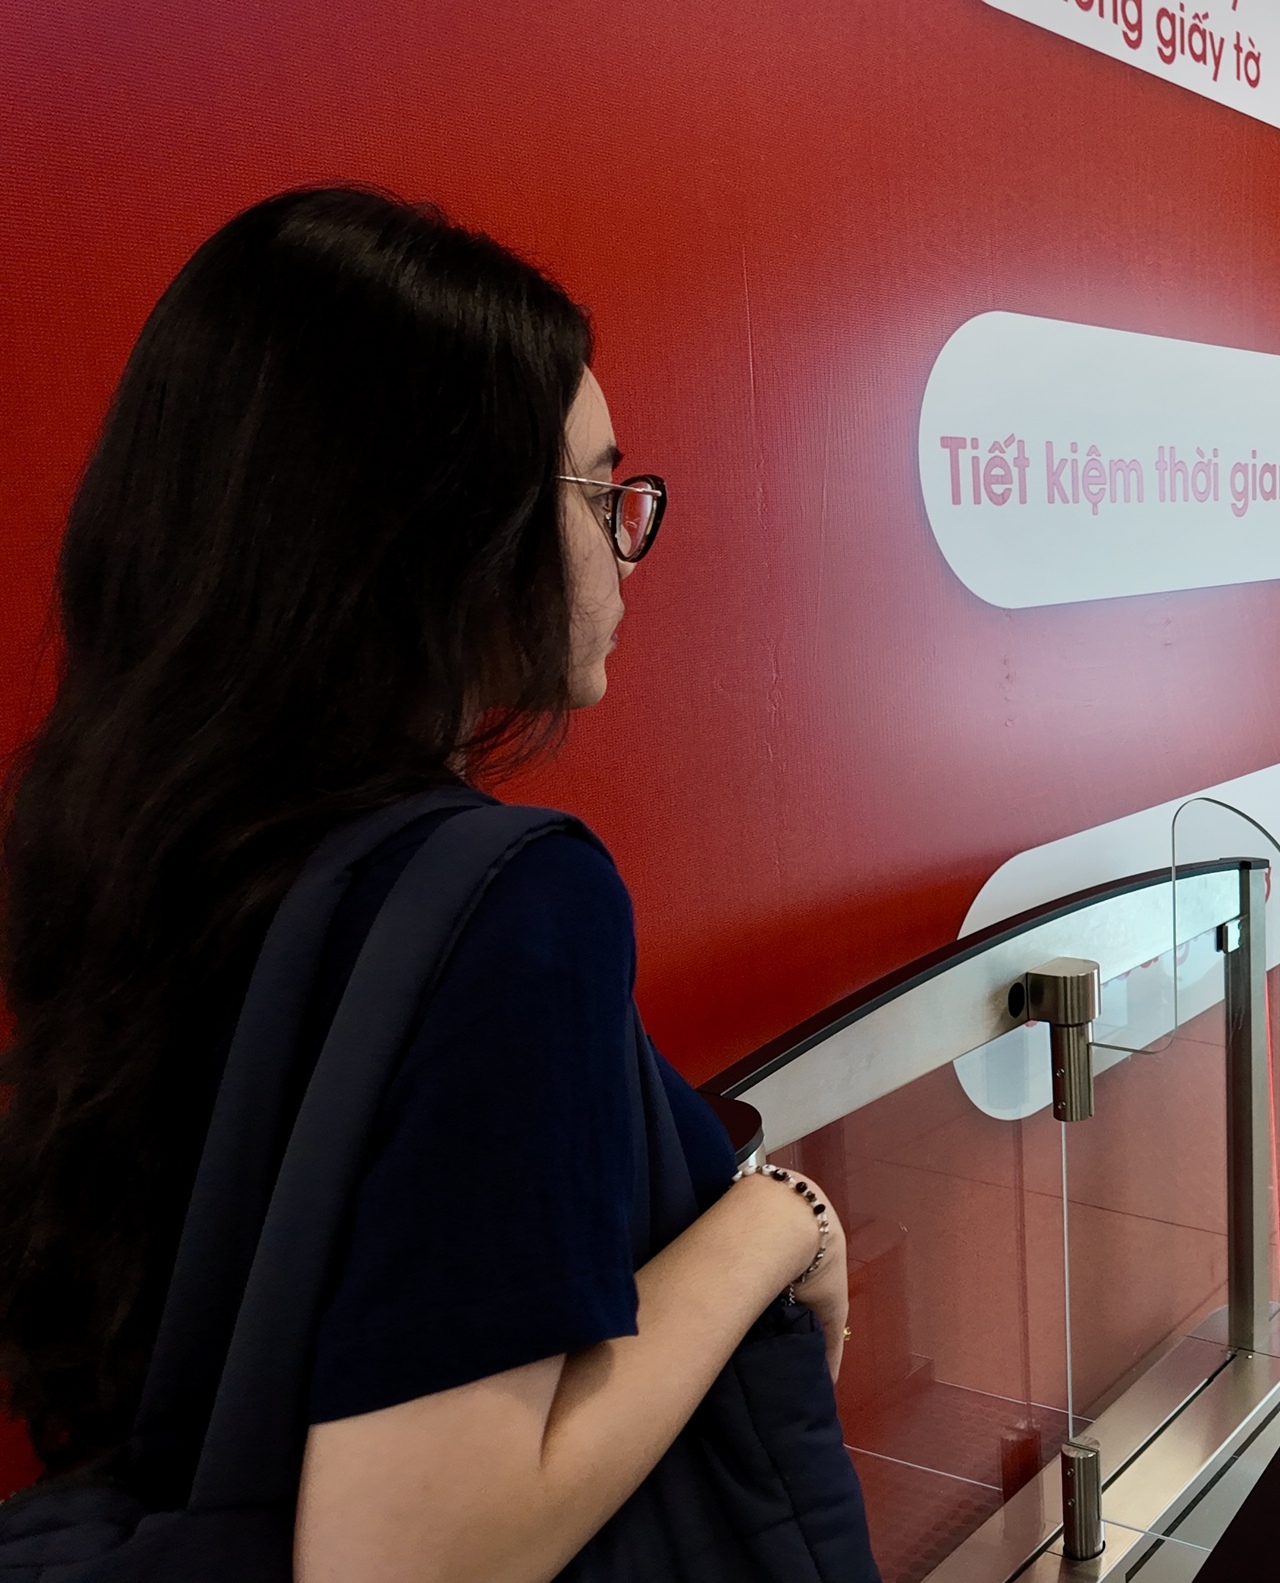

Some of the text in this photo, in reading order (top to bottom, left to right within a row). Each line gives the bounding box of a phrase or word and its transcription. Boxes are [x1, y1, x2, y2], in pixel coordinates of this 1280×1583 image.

[1156, 2, 1224, 82] giấy
[1233, 31, 1261, 88] tờ
[940, 433, 1030, 506] Tiết
[1045, 440, 1144, 516] kiệm
[1155, 445, 1219, 503] thời
